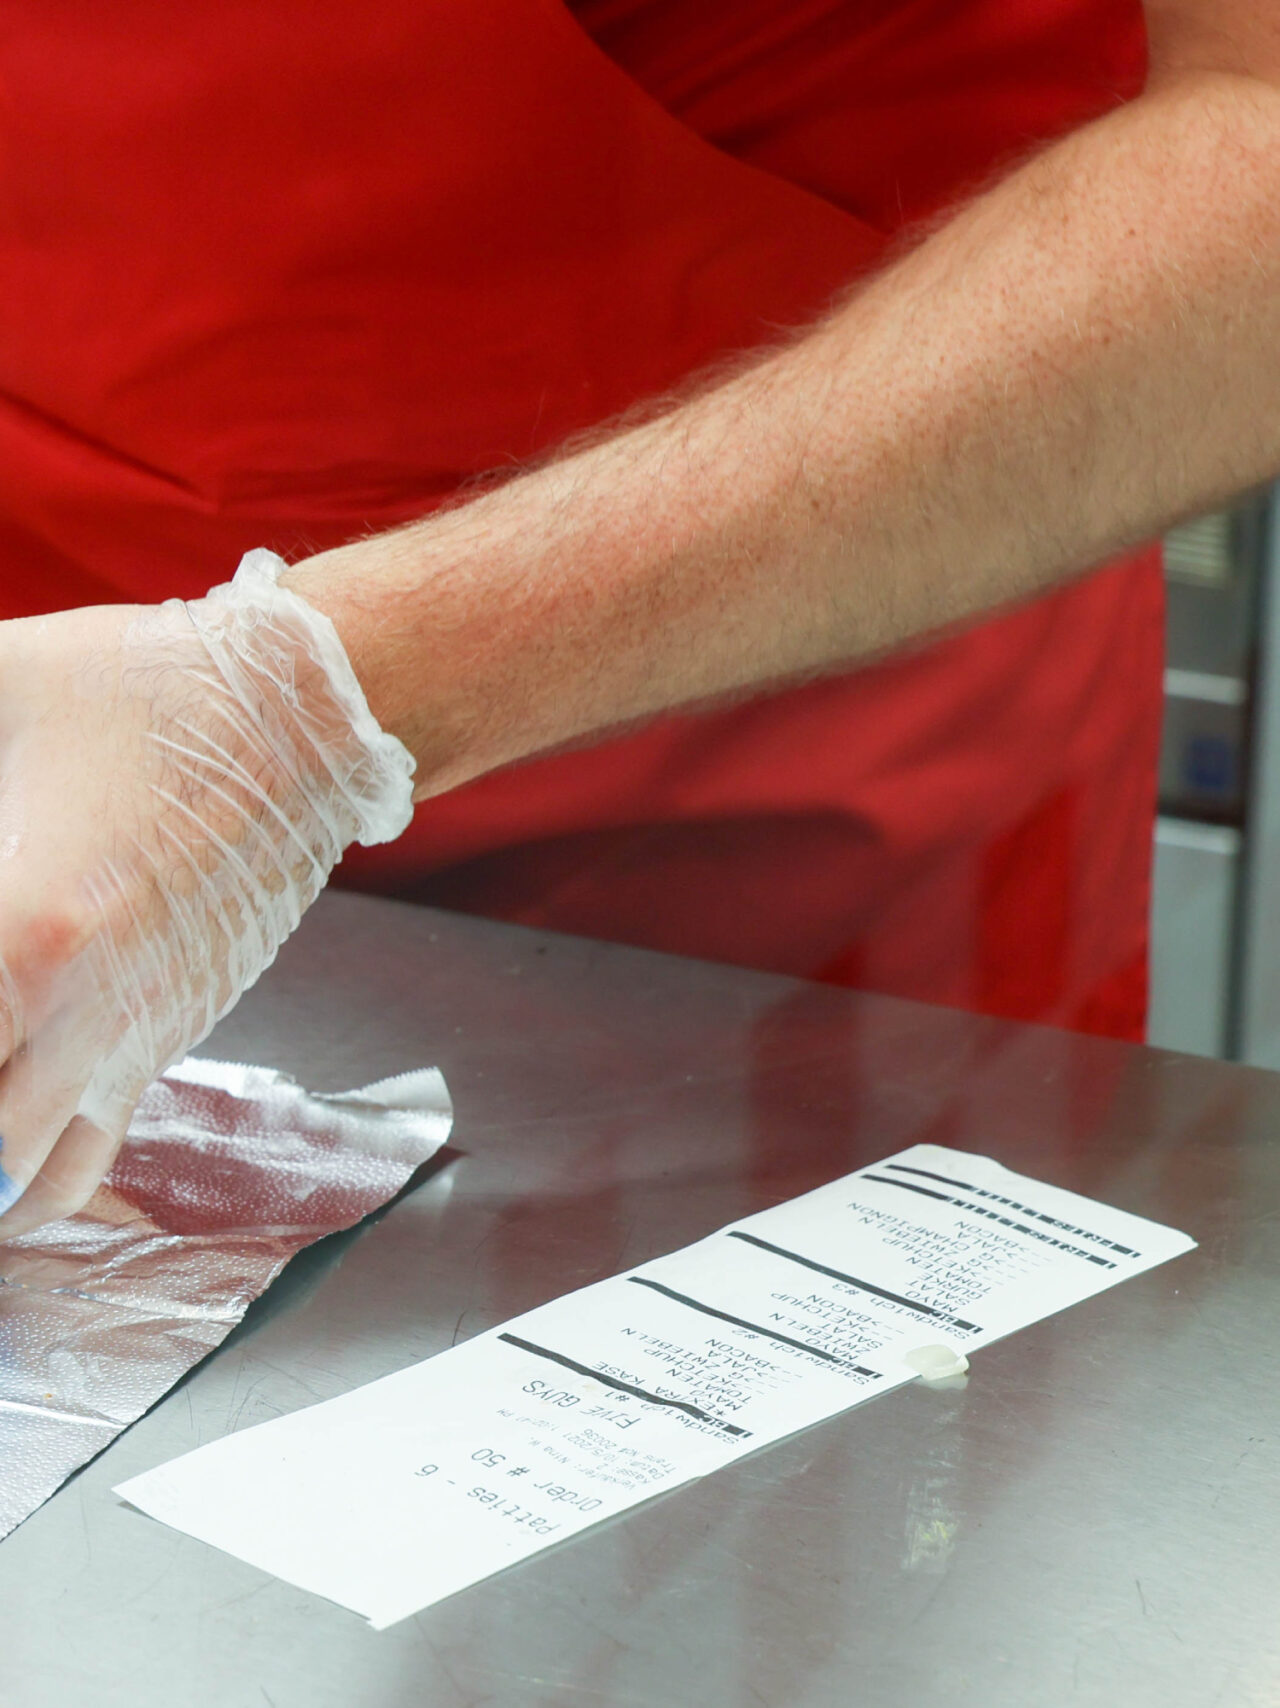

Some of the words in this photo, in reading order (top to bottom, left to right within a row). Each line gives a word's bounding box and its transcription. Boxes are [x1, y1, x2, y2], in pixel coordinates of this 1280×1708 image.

[847, 1202, 971, 1252] CHAMPIGNON
[858, 1216, 960, 1257] ZWIEBELN
[905, 1256, 992, 1294] TOMATEN
[918, 1272, 983, 1300] GURKE
[904, 1290, 959, 1313] MAYO
[905, 1279, 971, 1306] SALAT
[869, 1297, 971, 1340] Sandwich
[768, 1312, 871, 1355] ZWIEBELN
[816, 1322, 884, 1349] SALAT
[620, 1327, 721, 1370] ZWIEBELN
[804, 1337, 859, 1361] MAYO
[769, 1341, 870, 1386] Sandwich
[521, 1380, 581, 1408] GUYS
[604, 1391, 631, 1403] #1
[664, 1367, 752, 1405] TOMATEN
[579, 1405, 642, 1430] FIVE
[414, 1463, 440, 1477] 6
[470, 1448, 507, 1468] 50
[506, 1466, 531, 1477] #
[466, 1486, 561, 1535] Patties
[532, 1481, 604, 1512] Order
